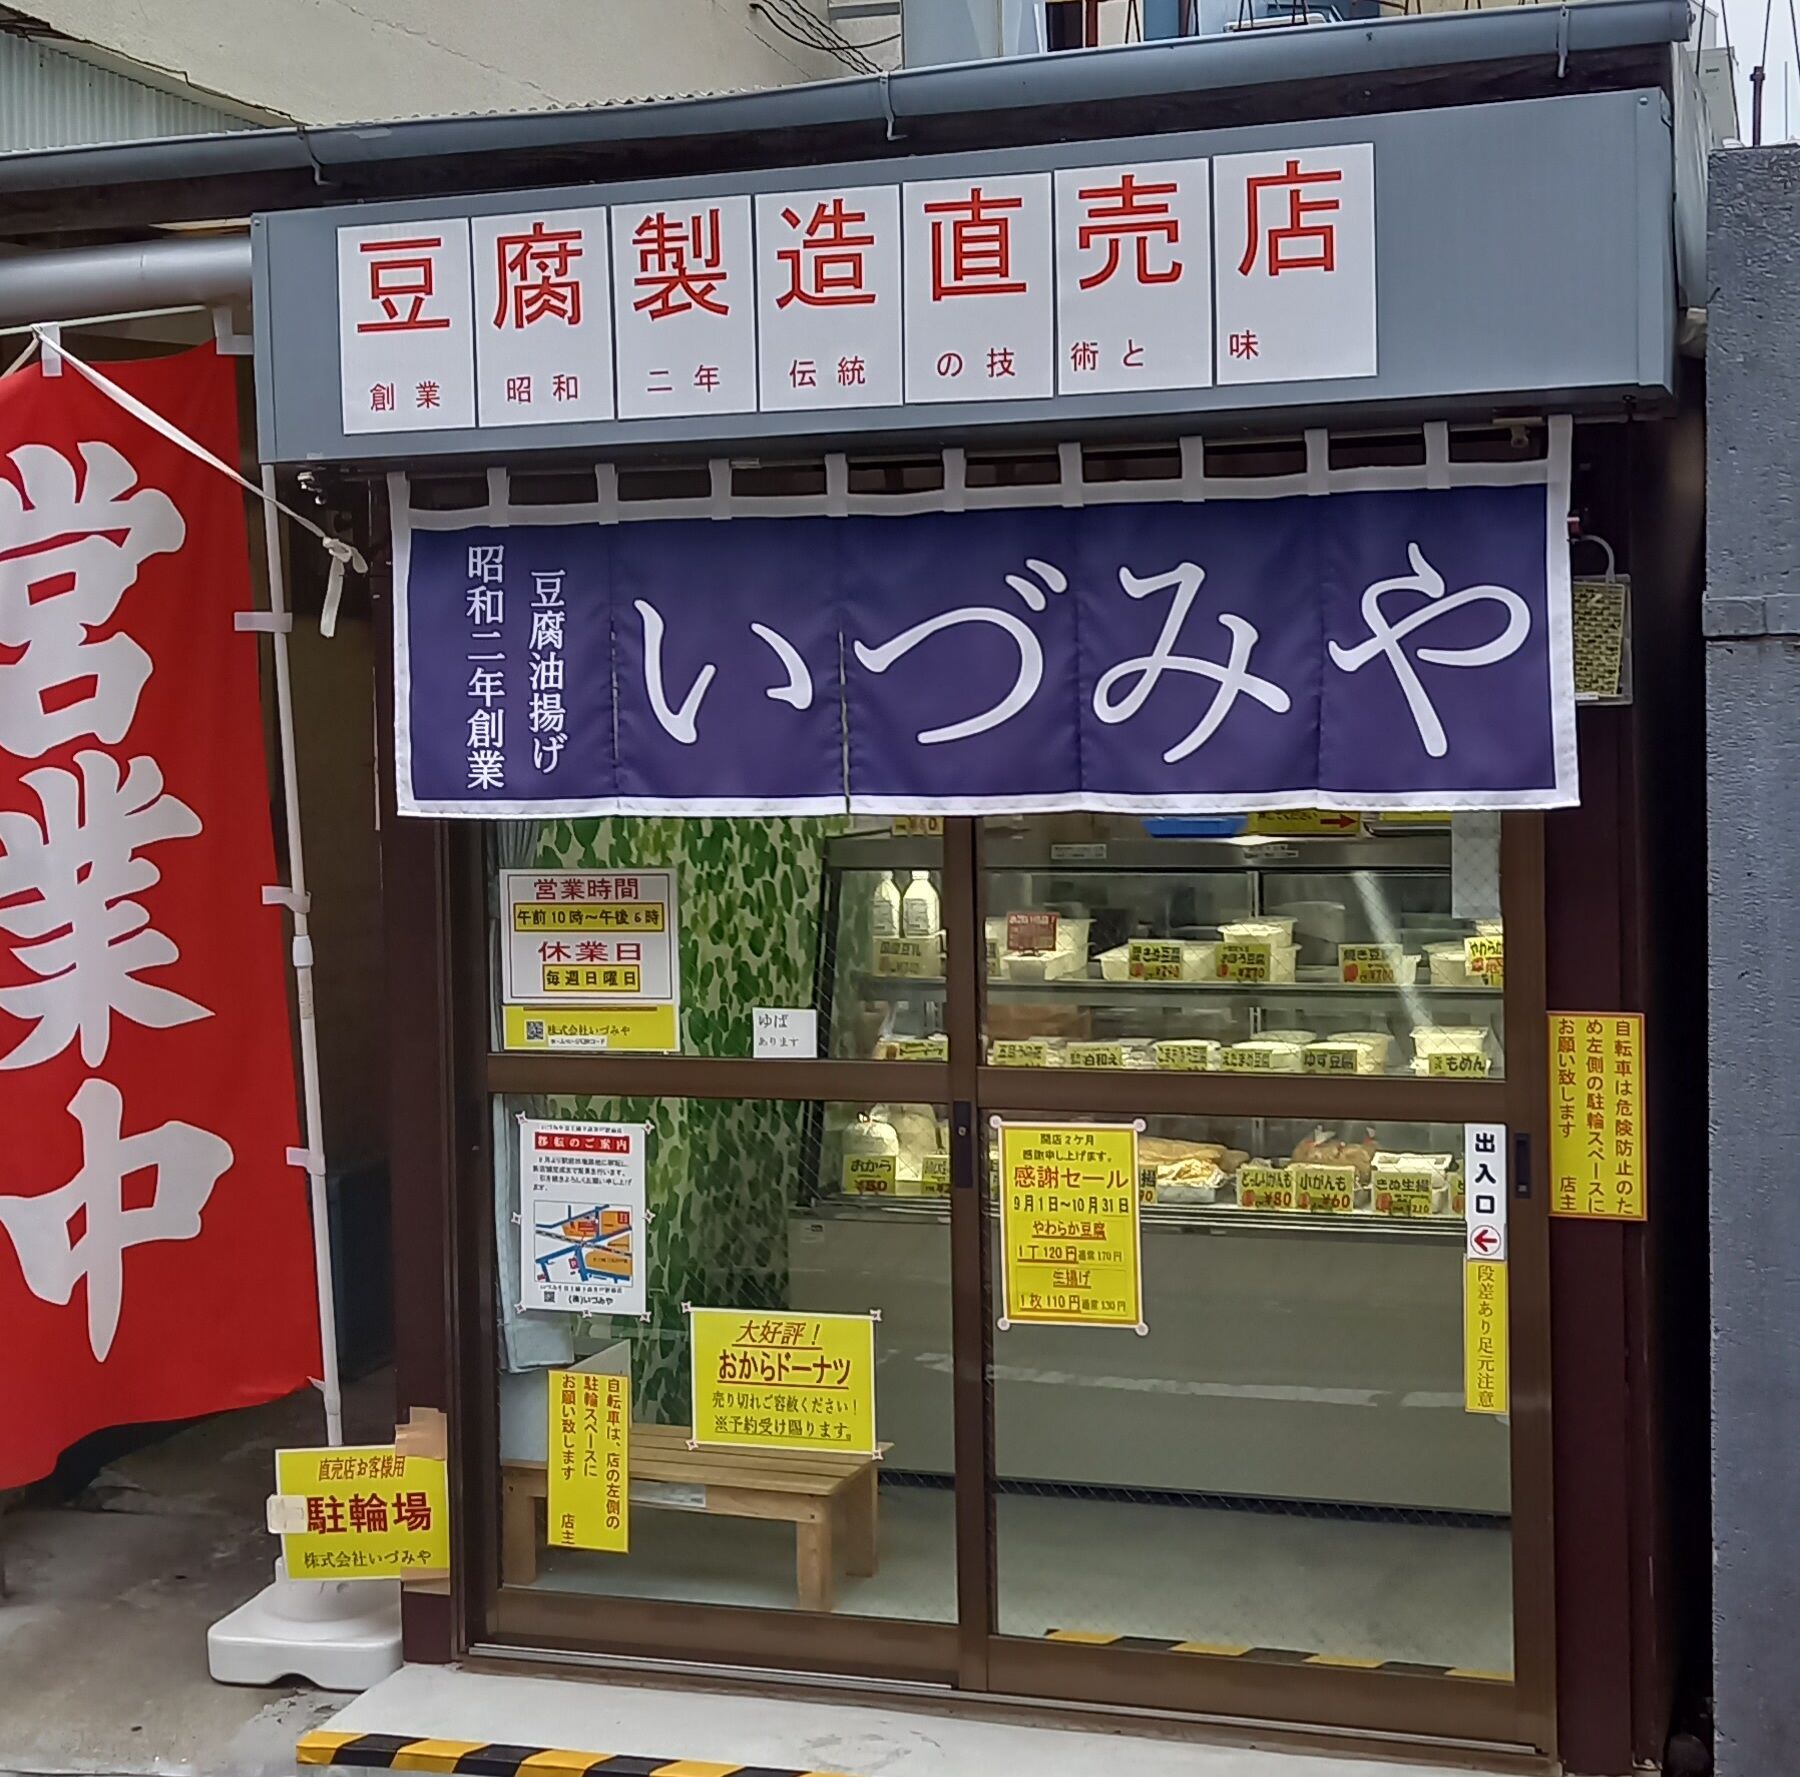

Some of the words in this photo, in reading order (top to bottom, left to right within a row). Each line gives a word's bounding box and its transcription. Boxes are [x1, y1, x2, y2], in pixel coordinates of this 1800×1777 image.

[356, 160, 1343, 334] 豆腐製造直売店
[466, 544, 506, 791] 昭和二年創業
[528, 568, 567, 774] 豆腐油揚げ
[633, 541, 1532, 763] いづみや
[0, 440, 235, 1363] 営業中
[533, 877, 639, 901] 営業時間
[537, 940, 642, 963] 休業日
[546, 970, 637, 986] 毎週日曜日
[758, 1013, 788, 1029] ゆば
[758, 1036, 799, 1048] あります
[1558, 1018, 1576, 1139] お願い致します
[1586, 1019, 1605, 1213] め左側の駐輪スペースに
[1614, 1020, 1634, 1215] 自転車は危険防止のた
[537, 1135, 627, 1151] 移転のご案内
[851, 1159, 892, 1173] おから
[1014, 1166, 1129, 1189] 感謝セール
[1474, 1132, 1496, 1214] 出入口
[1559, 1175, 1577, 1211] 店主
[1032, 1220, 1106, 1238] やわらか豆腐
[1476, 1264, 1495, 1408] 段差あり足元注意
[718, 1349, 851, 1385] おからドーナツ
[561, 1374, 576, 1481] お願い致します
[584, 1375, 599, 1478] 駐輪スペースに
[318, 1454, 406, 1481] 直売店お客様用
[606, 1378, 621, 1530] 自転車は、店の左側の
[306, 1491, 431, 1535] 駐輪場
[561, 1513, 576, 1545] 店主
[303, 1550, 432, 1568] 株式会社いづみや
